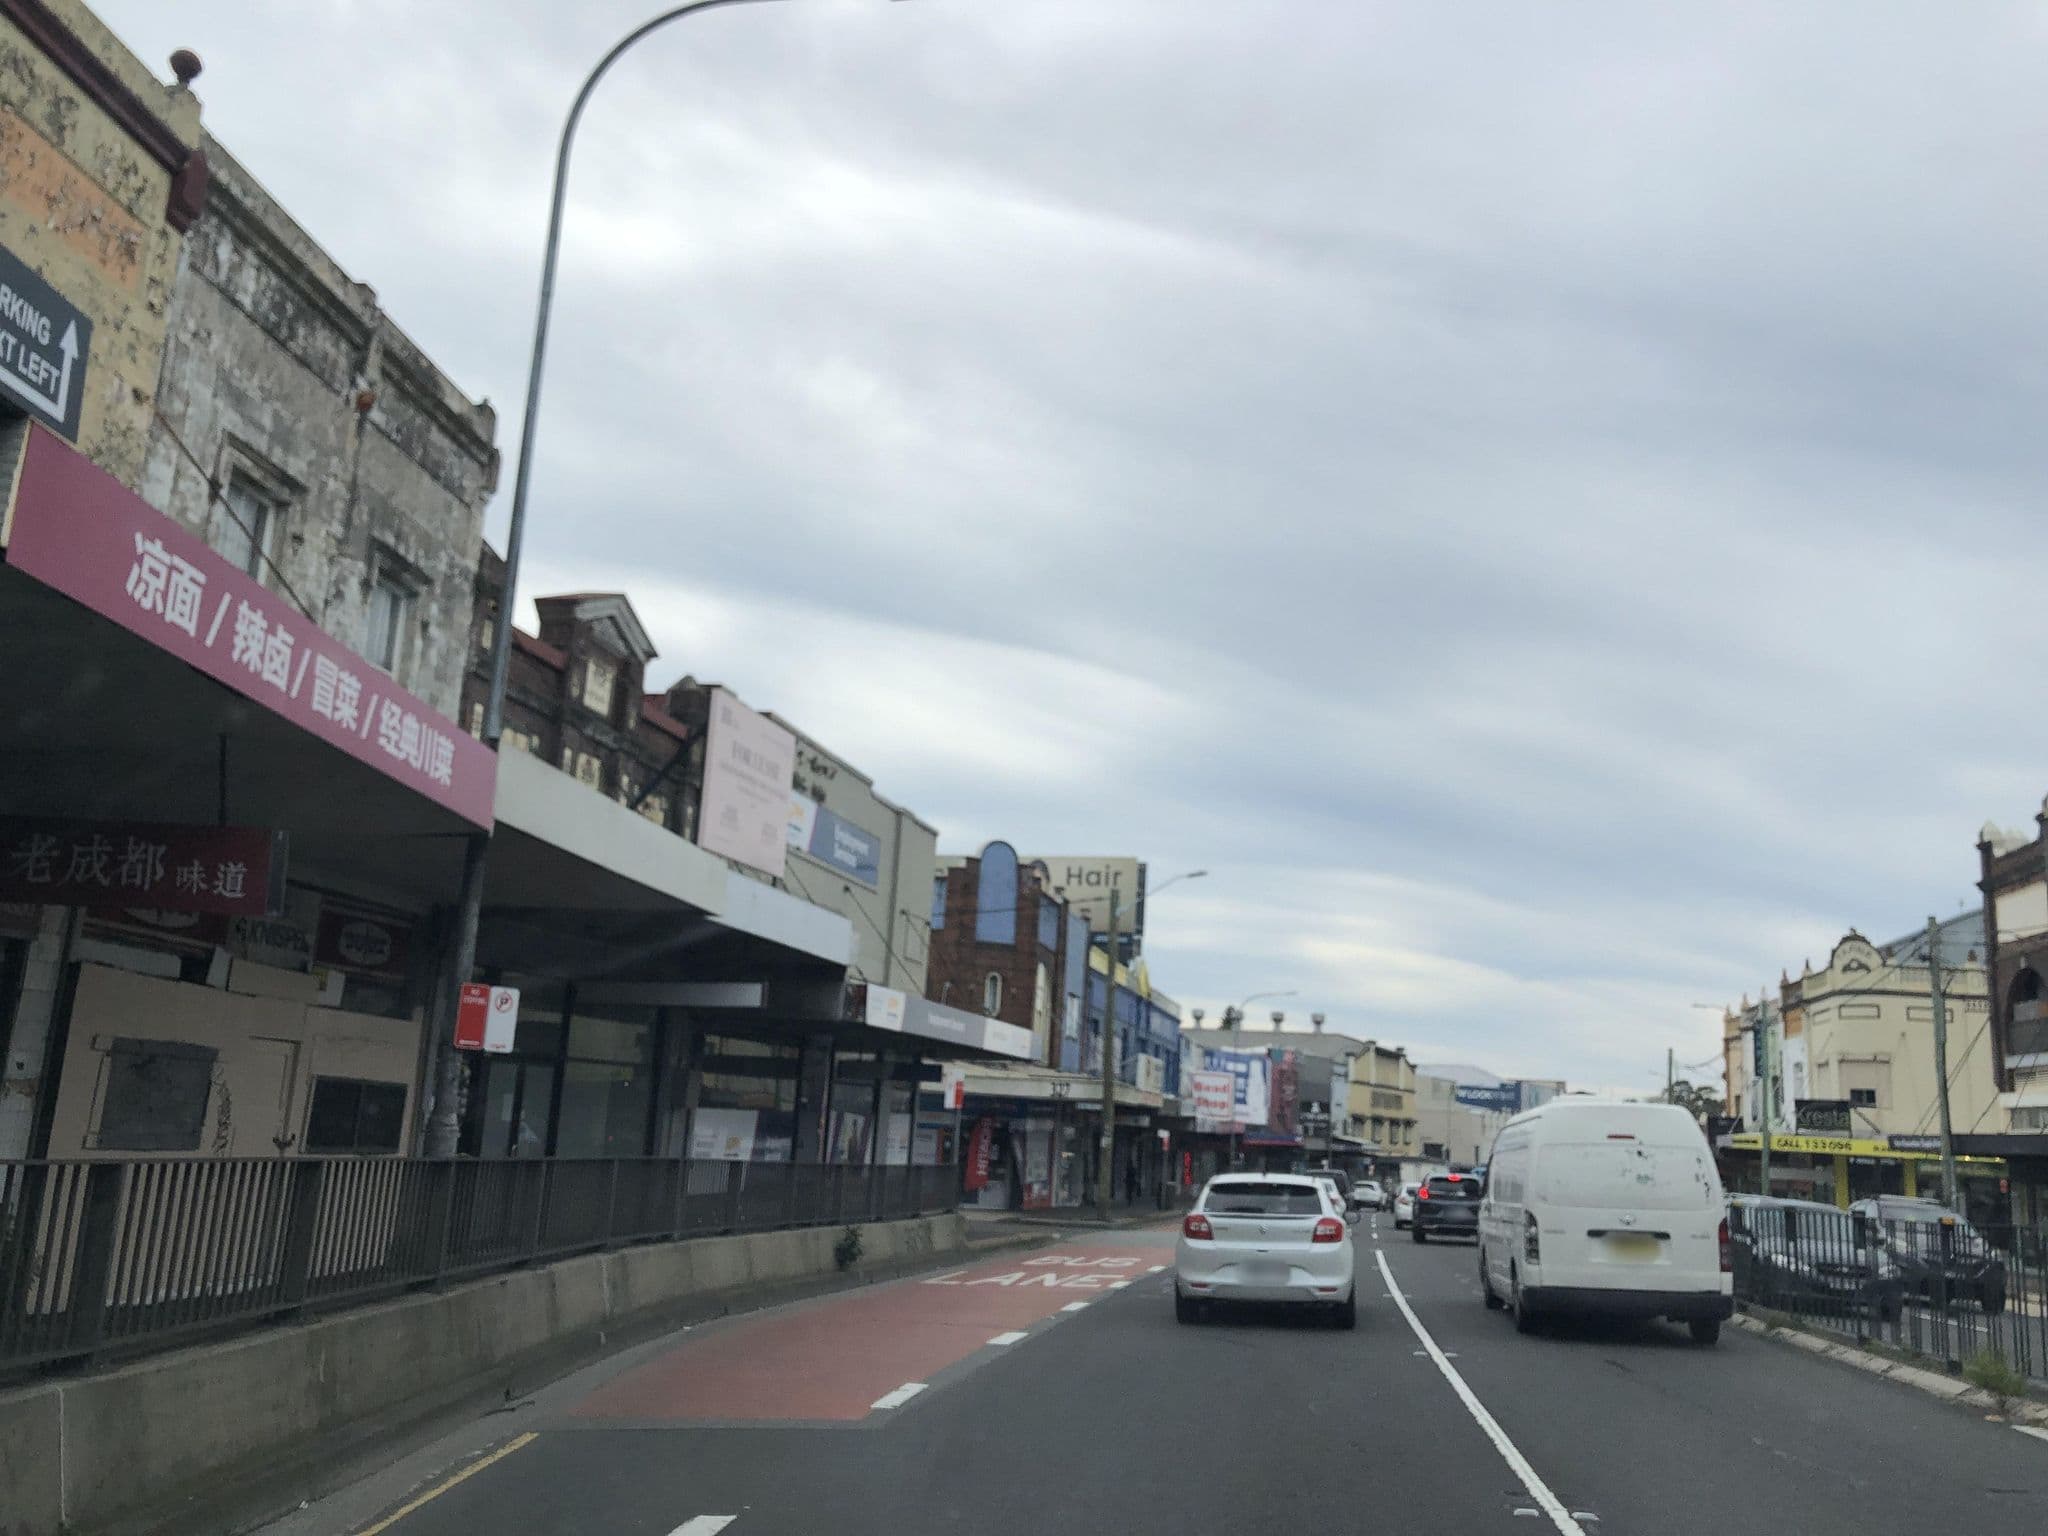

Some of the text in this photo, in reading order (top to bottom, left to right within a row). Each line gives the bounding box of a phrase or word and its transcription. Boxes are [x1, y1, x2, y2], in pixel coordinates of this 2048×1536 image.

[0, 283, 51, 346] RKING
[18, 343, 61, 394] LEFT
[126, 531, 208, 638] 凉面
[231, 599, 296, 693] 辣卤
[311, 652, 362, 733] 冒菜
[1066, 864, 1123, 887] Hair
[919, 1271, 1125, 1288] LANE
[1021, 1256, 1142, 1268] BUS
